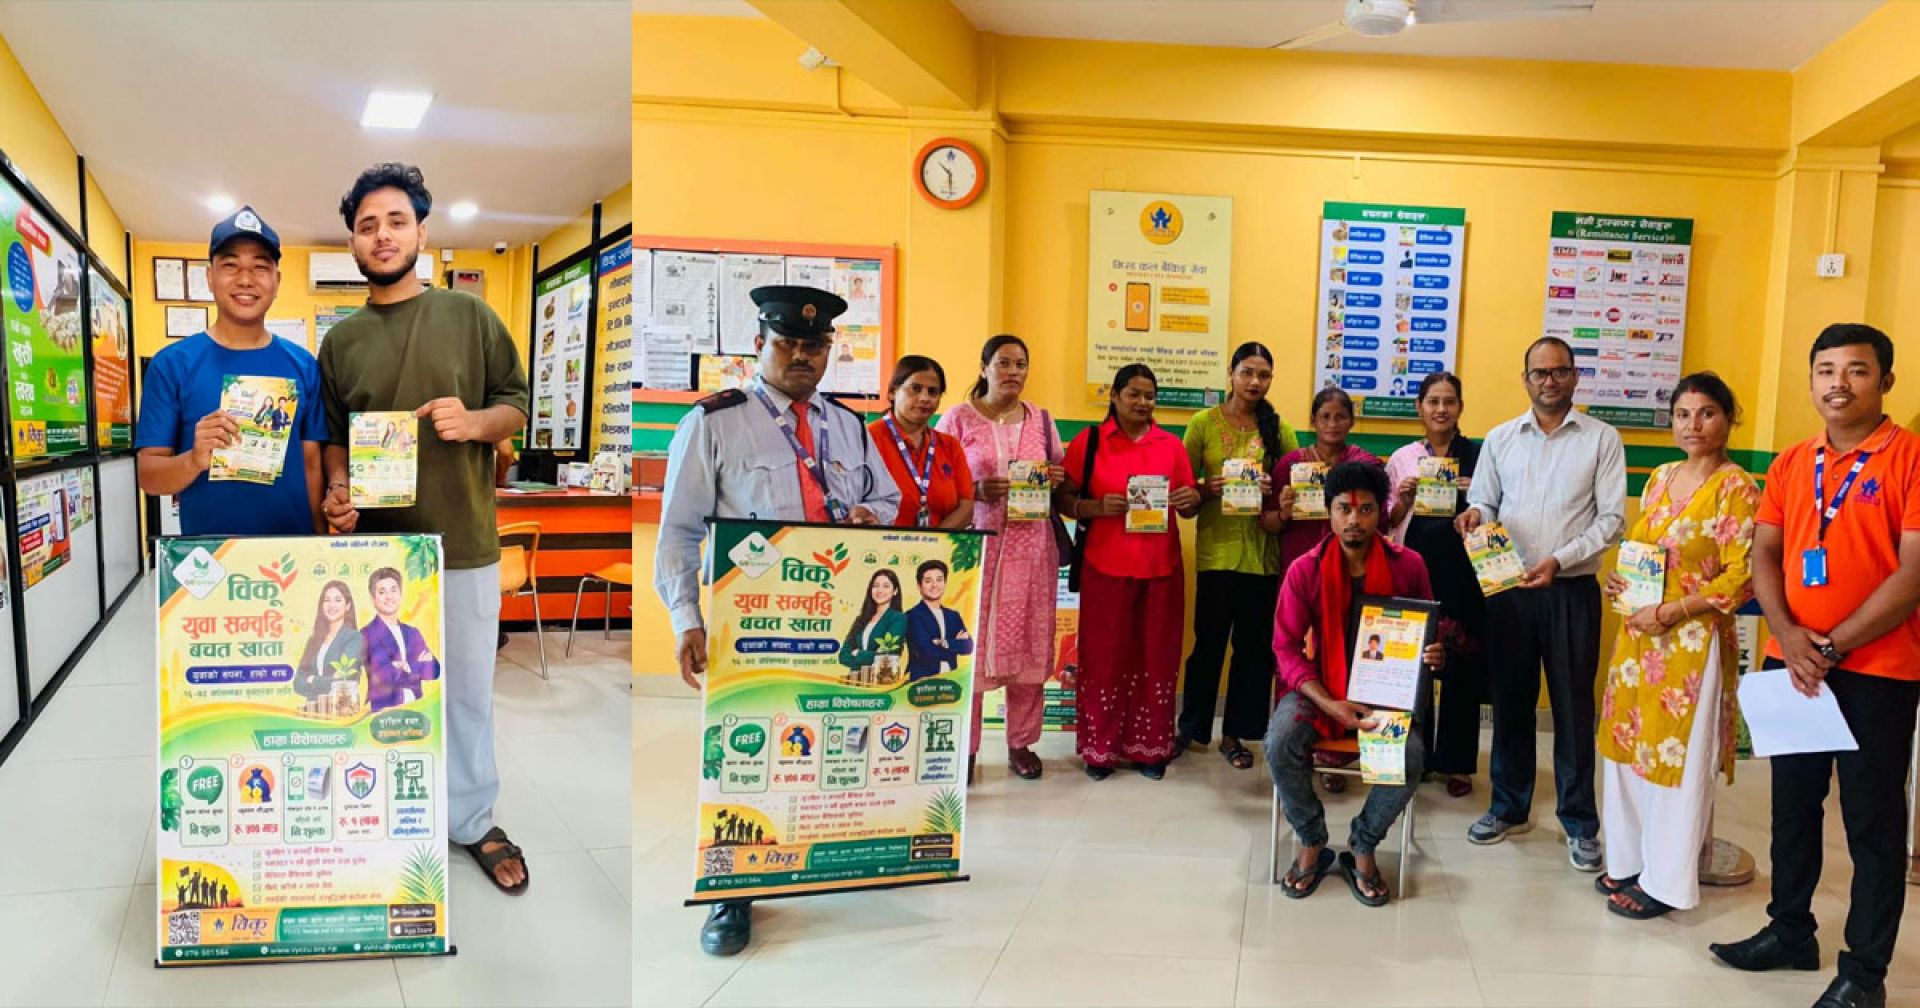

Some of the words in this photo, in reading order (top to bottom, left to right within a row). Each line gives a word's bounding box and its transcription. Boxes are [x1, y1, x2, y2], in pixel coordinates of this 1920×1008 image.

[228, 574, 283, 606] विकू
[734, 593, 768, 613] युवा
[183, 616, 217, 639] युवा
[740, 616, 781, 631] बचत
[788, 616, 832, 632] खाता
[189, 642, 231, 657] बचत
[238, 641, 283, 657] खाता
[735, 731, 761, 745] FREE
[192, 775, 219, 792] FREE
